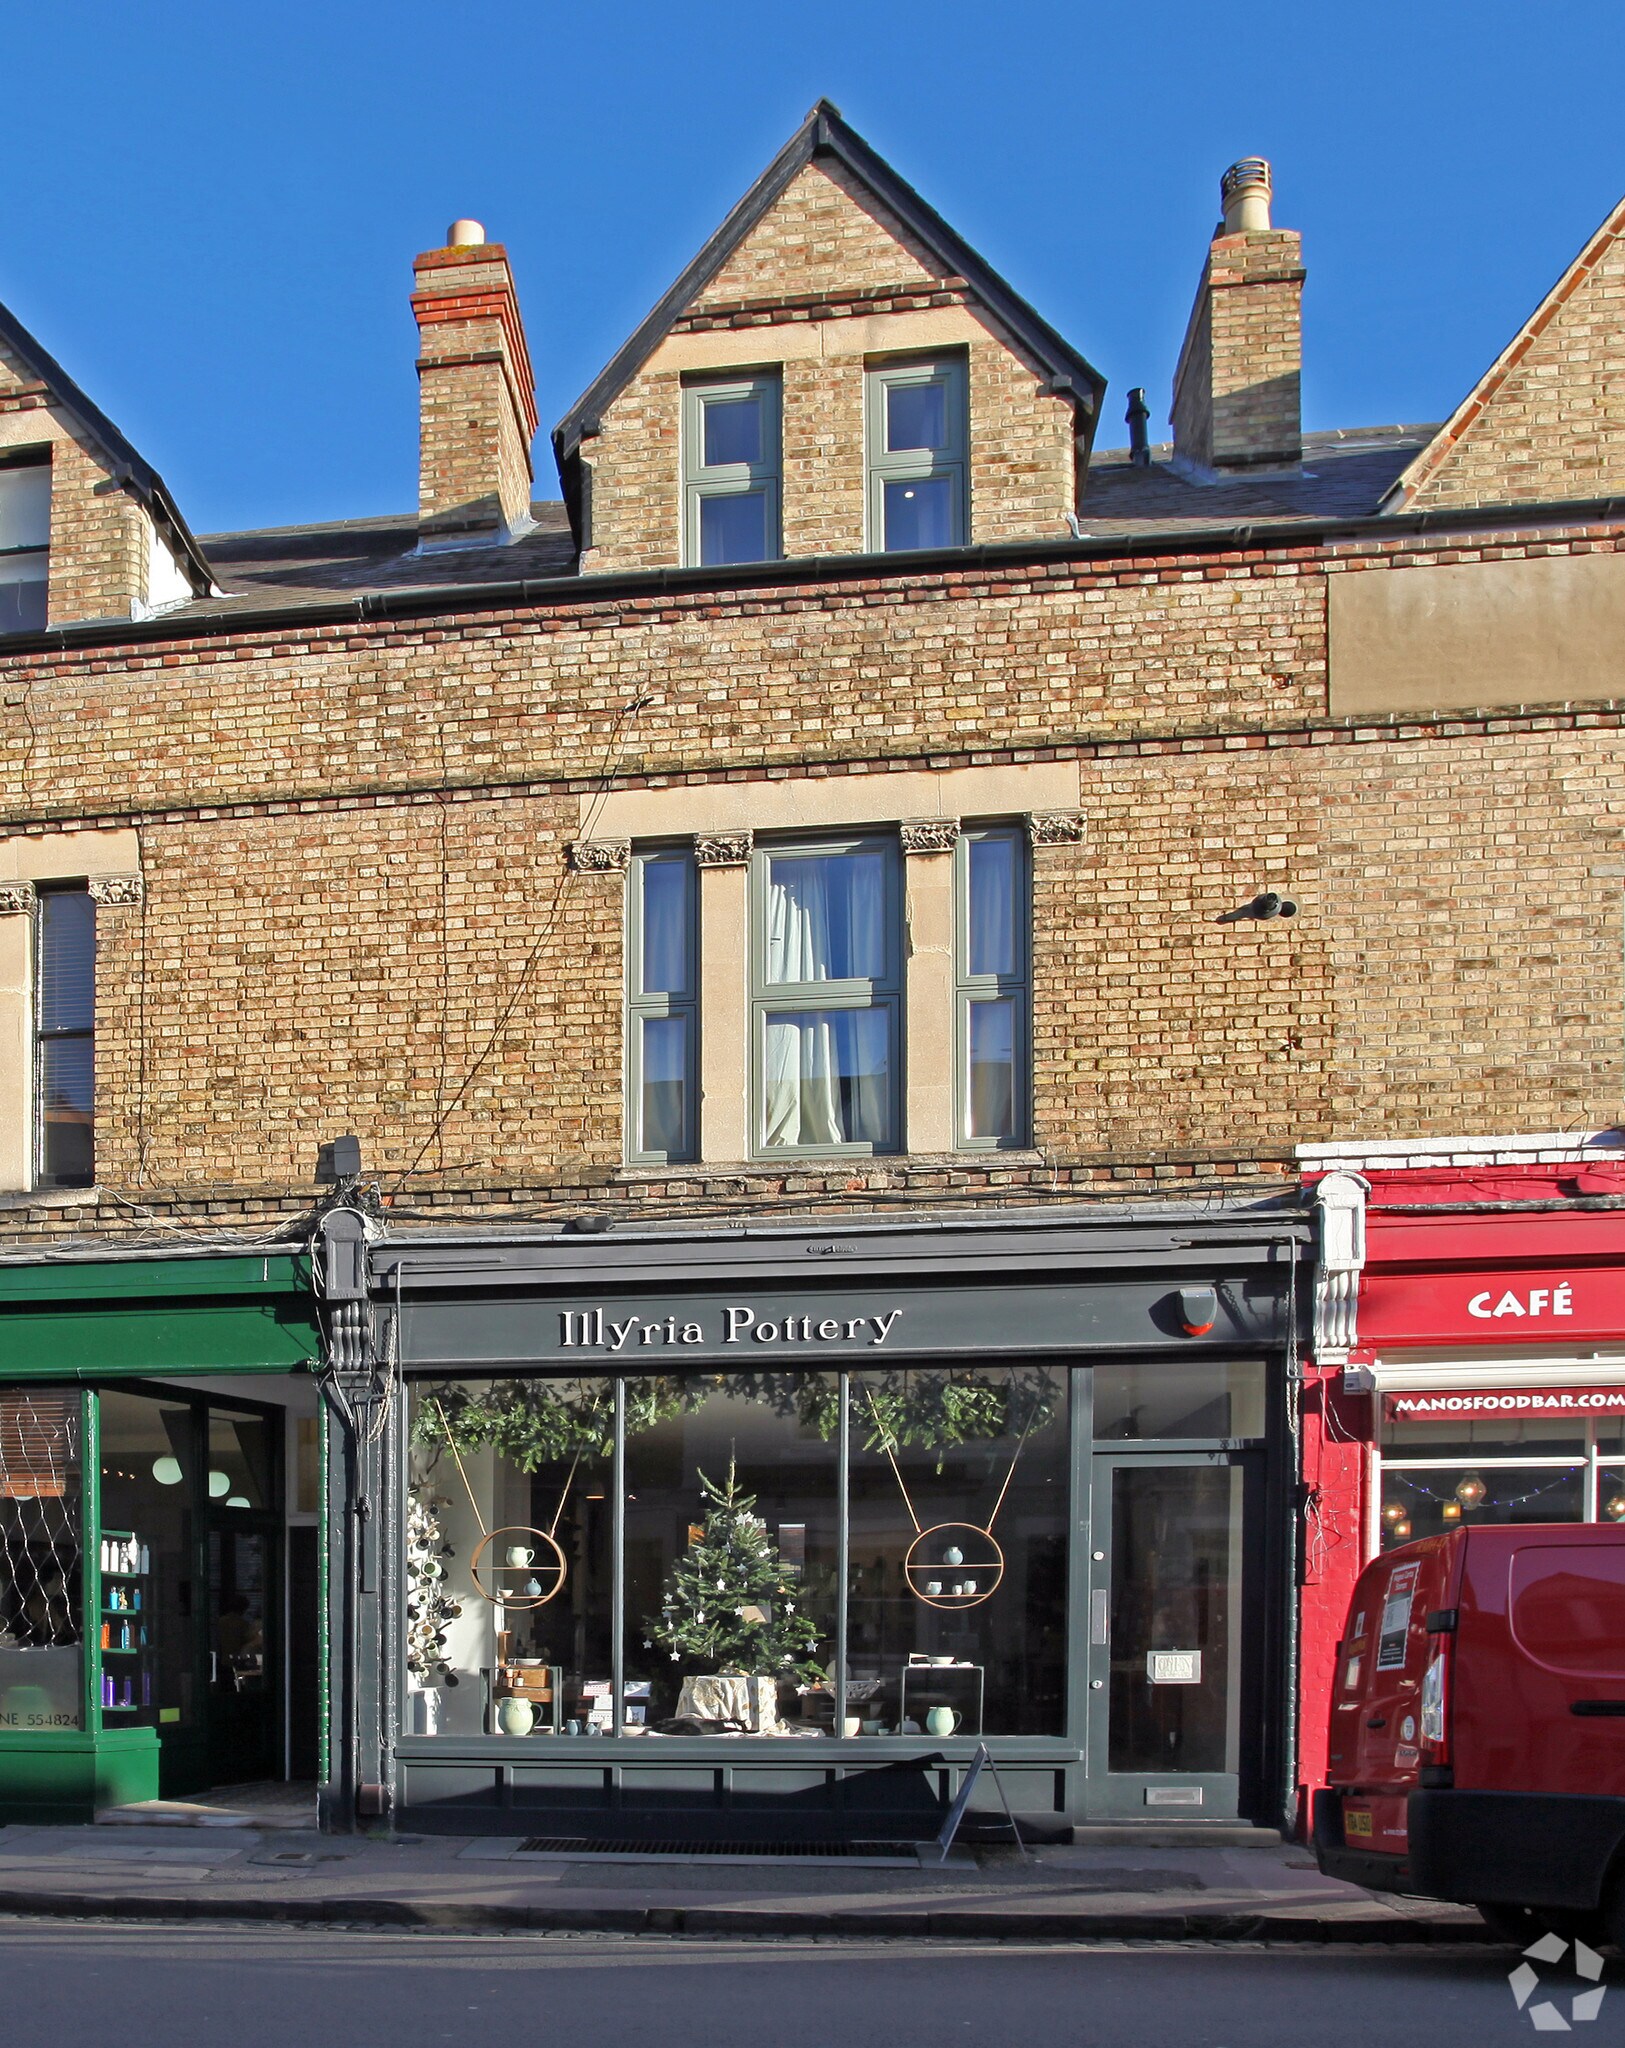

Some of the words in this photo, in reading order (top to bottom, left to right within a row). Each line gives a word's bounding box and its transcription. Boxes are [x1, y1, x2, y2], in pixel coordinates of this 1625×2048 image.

[1467, 1281, 1574, 1318] CAFÉ
[561, 1307, 704, 1350] Illyria
[726, 1306, 903, 1345] Pottery
[1395, 1393, 1625, 1412] MANOSFOODBAR.COM
[27, 1713, 79, 1726] 554824
